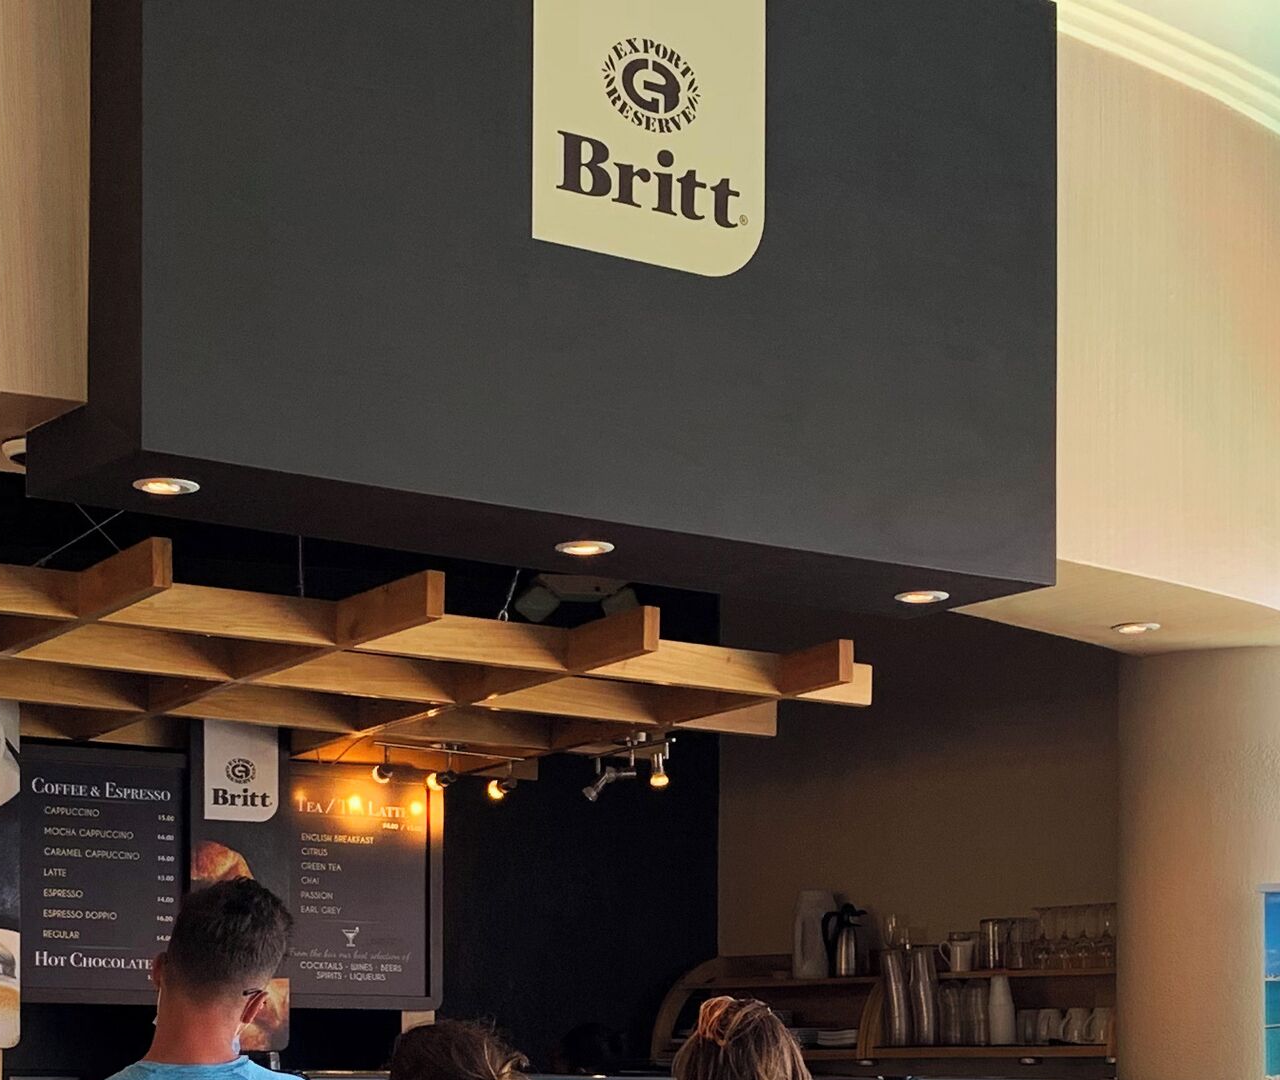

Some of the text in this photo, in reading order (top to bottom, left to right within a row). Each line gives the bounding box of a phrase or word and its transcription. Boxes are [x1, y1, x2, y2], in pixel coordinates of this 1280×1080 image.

[612, 37, 693, 79] EXPORT
[606, 87, 696, 133] RESERVE
[556, 130, 740, 229] Britt
[31, 777, 171, 801] COFFEE & ESPRESSO
[212, 788, 271, 807] Britt
[44, 807, 100, 817] CAPPUCCINO
[44, 827, 134, 840] MOCHA CAPPUCCINO
[301, 833, 374, 844] ENGLISH BREAKFAST
[44, 848, 140, 860] CARAMEL CAPPUCCINO
[301, 848, 328, 857] CITRUS
[301, 862, 342, 872] GREEN TEA
[43, 868, 67, 878] LATTE
[301, 876, 320, 885] CHAI
[43, 888, 84, 898] ESPRESSO
[300, 891, 333, 900] PASSION
[43, 909, 118, 921] ESPRESSO DOPPIO
[300, 905, 342, 915] EARL GREY
[42, 929, 80, 940] REGULAR
[35, 951, 153, 970] HOT CHOCOLATE
[300, 961, 344, 971] COCKTAILS
[350, 963, 373, 972] WINES
[380, 964, 402, 972] BEERS
